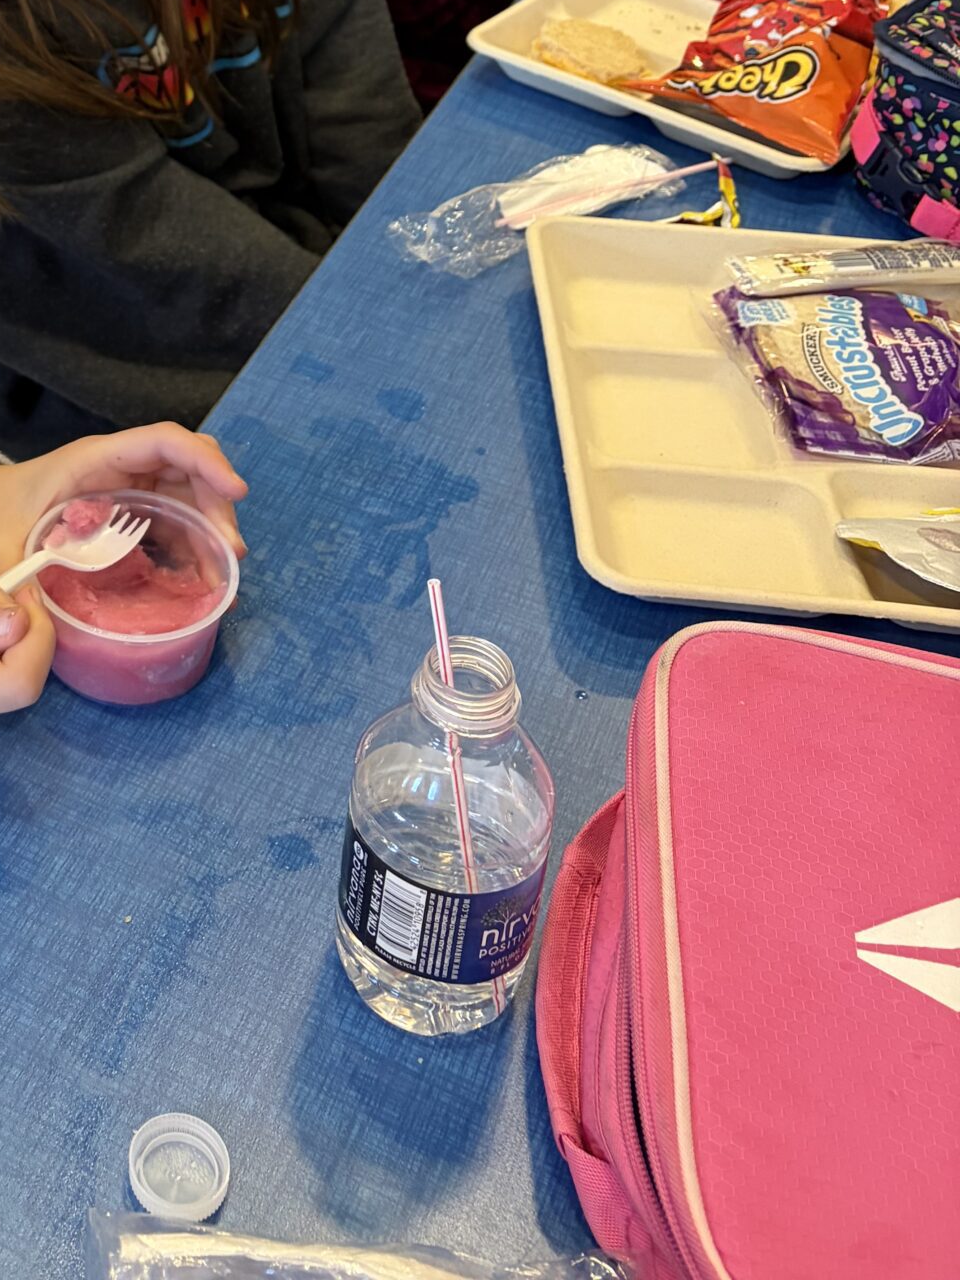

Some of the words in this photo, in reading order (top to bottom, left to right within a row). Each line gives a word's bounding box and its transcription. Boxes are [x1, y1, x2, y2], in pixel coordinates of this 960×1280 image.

[696, 49, 815, 100] Cheet
[905, 355, 929, 391] Peanut
[924, 336, 948, 375] andwich
[347, 855, 362, 924] nirvana
[353, 885, 364, 931] POSITIVELY
[478, 928, 529, 960] POSITIV
[392, 957, 417, 971] RECYCLE
